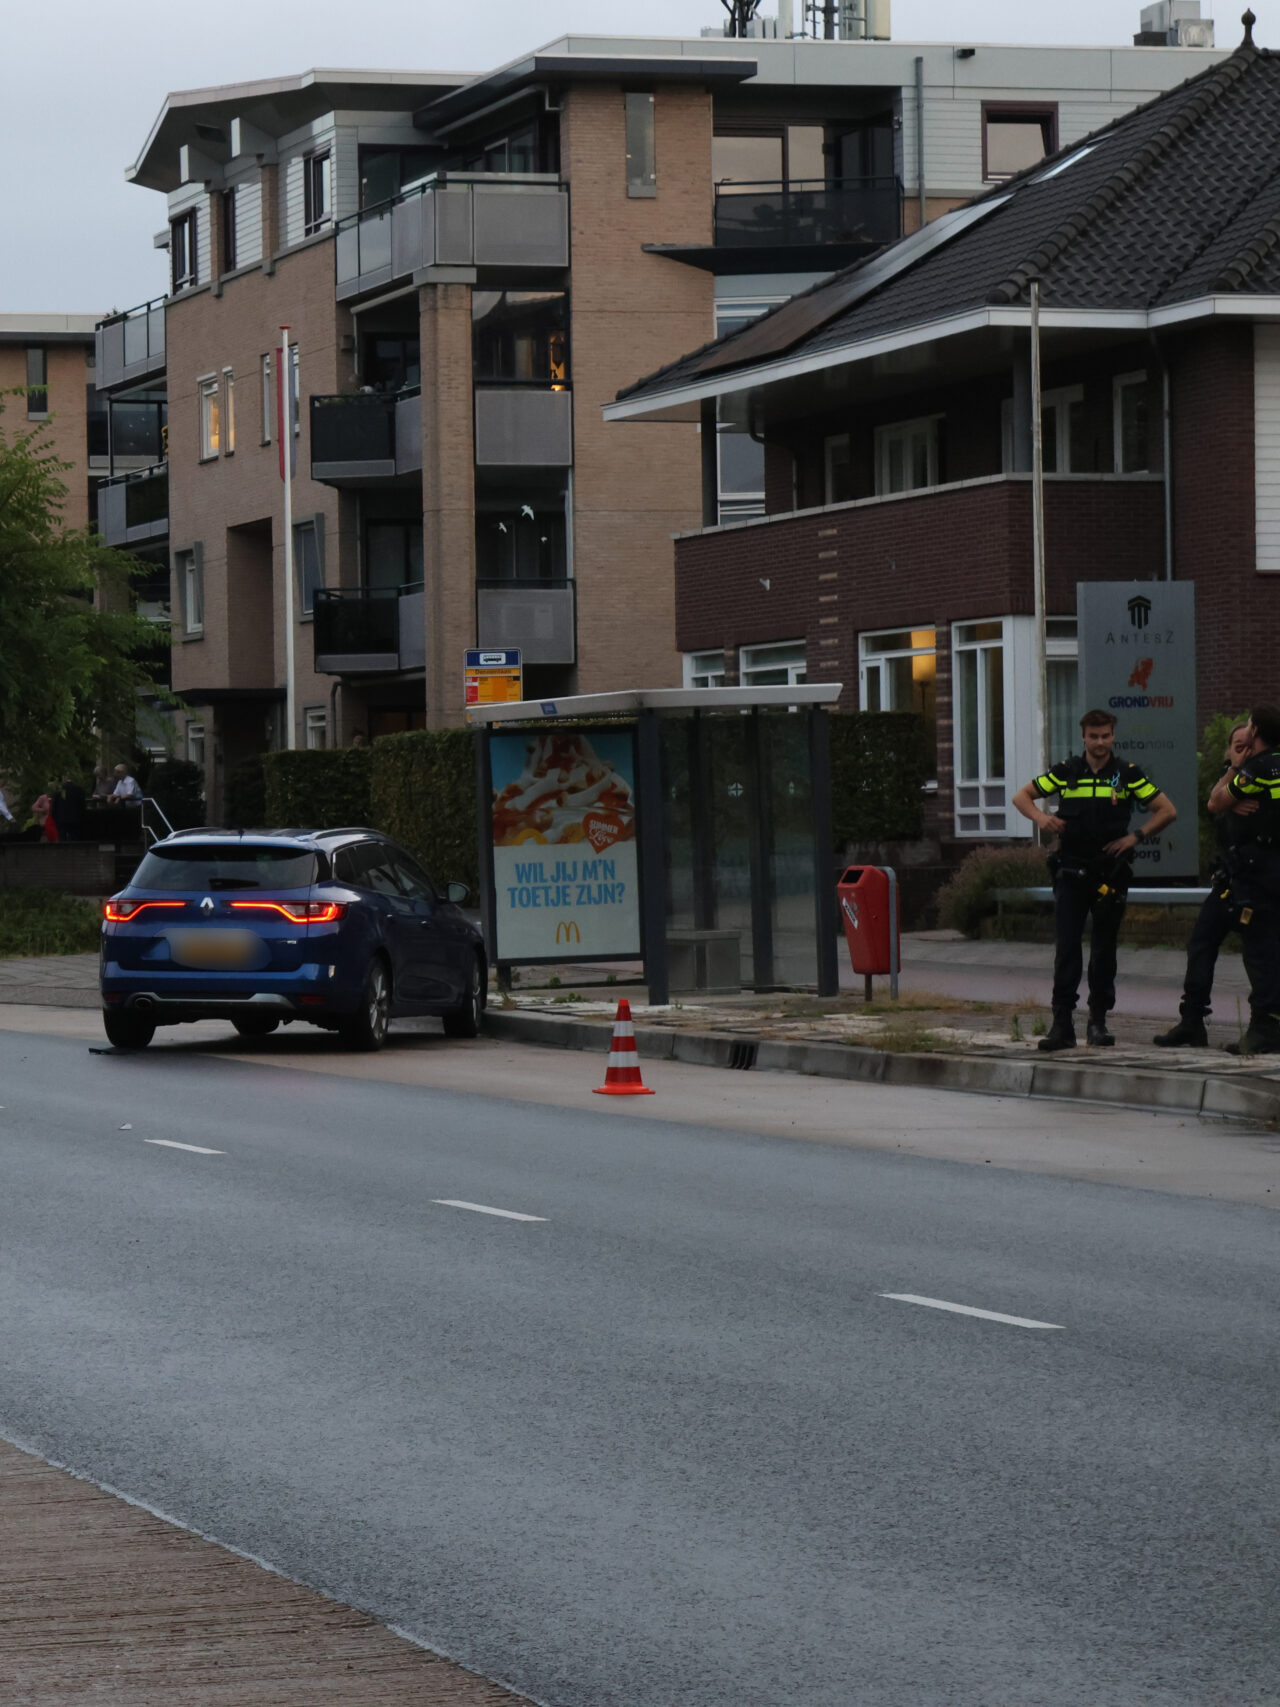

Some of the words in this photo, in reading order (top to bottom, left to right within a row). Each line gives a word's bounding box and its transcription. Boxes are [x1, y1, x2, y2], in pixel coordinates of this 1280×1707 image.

[1108, 695, 1175, 708] GRONDVRIJ
[514, 862, 548, 884] WIL
[550, 860, 578, 883] JIJ
[582, 858, 616, 881] M'N
[506, 885, 572, 908] TOETJE
[575, 882, 626, 906] ZIJN?
